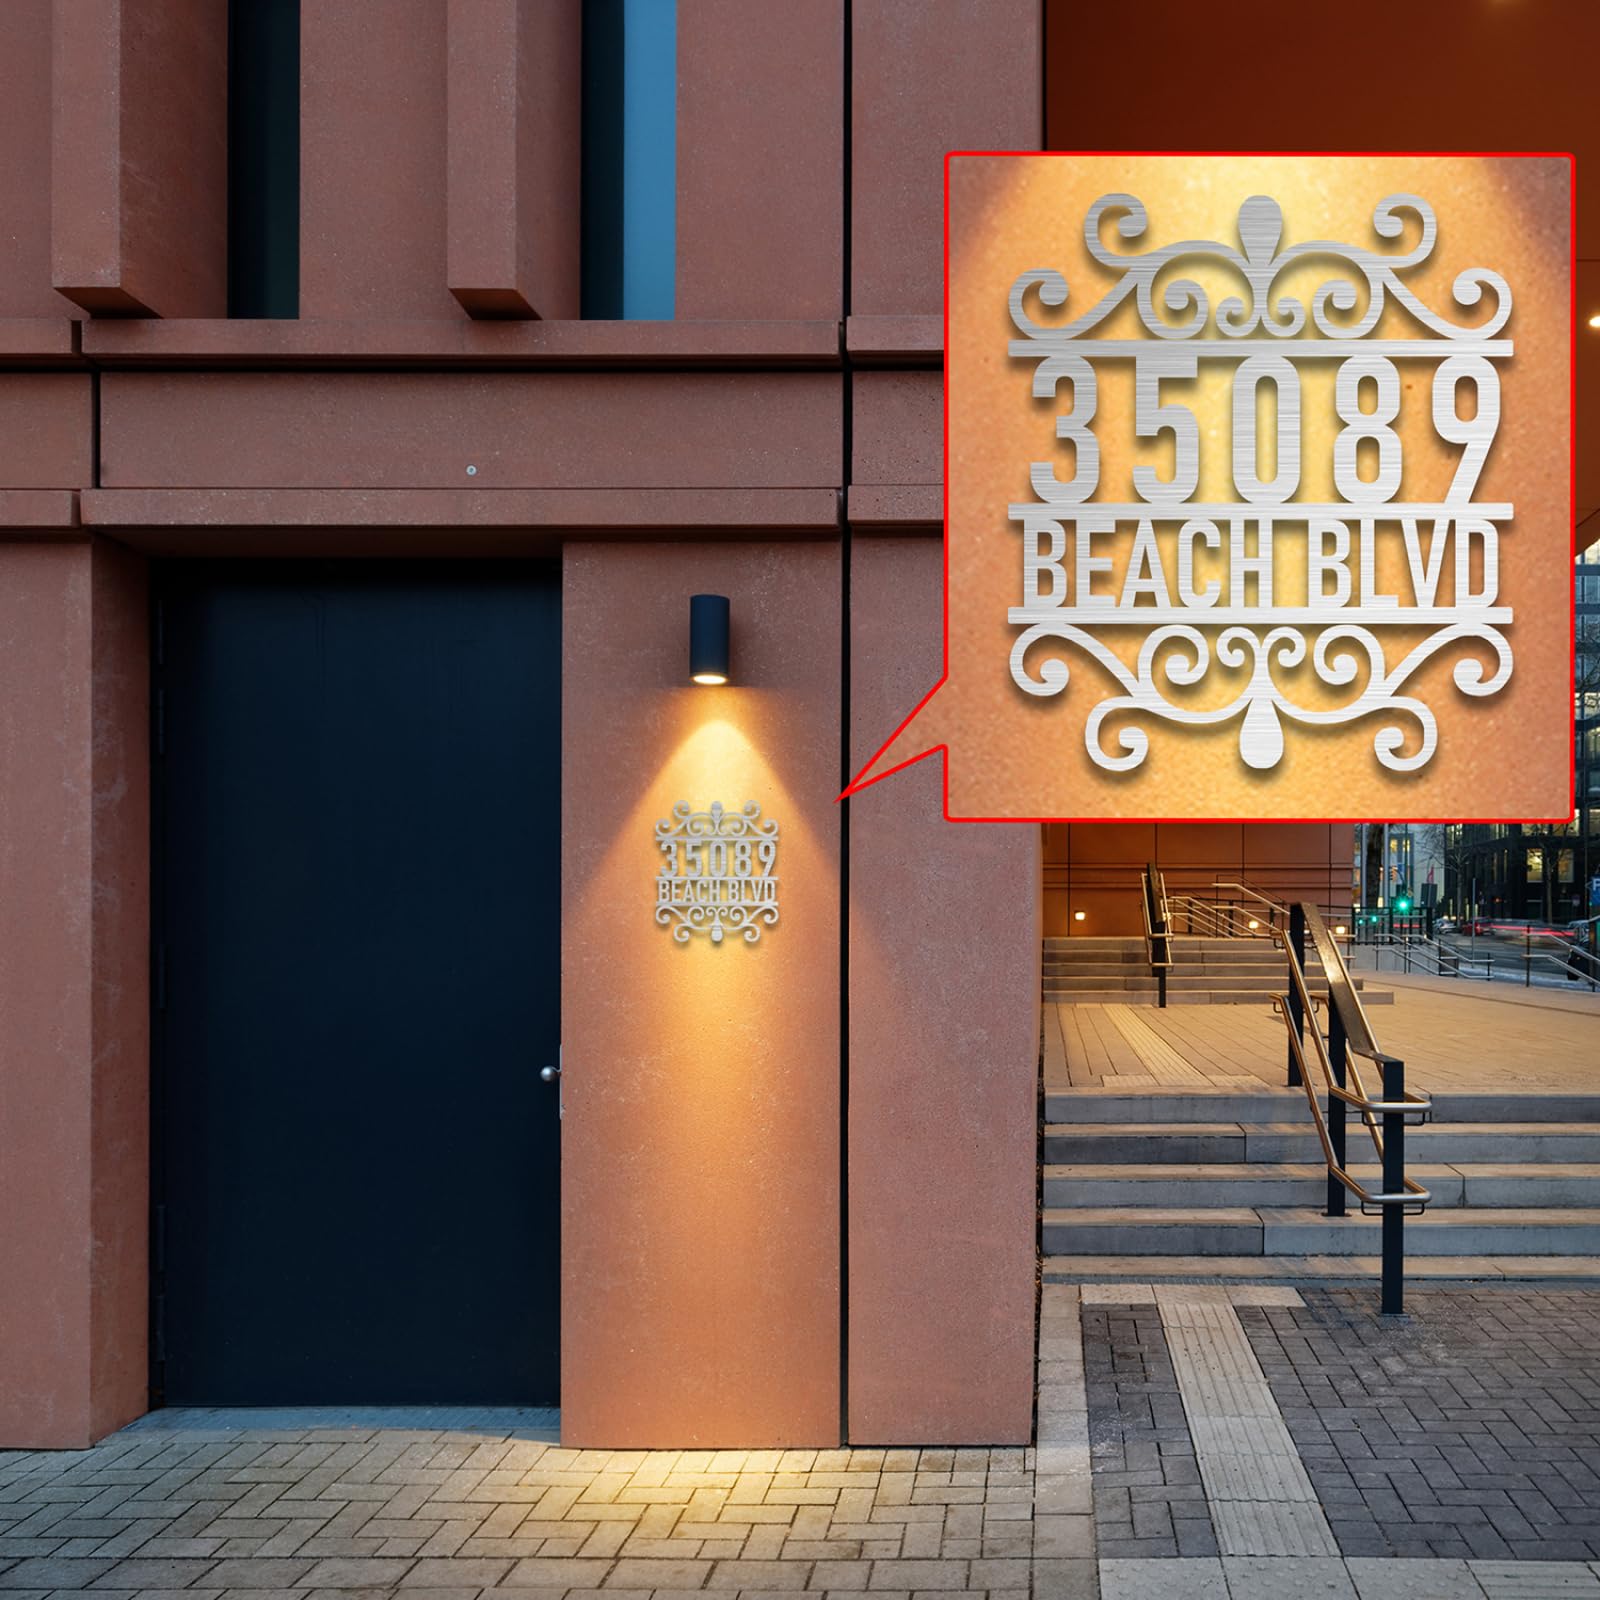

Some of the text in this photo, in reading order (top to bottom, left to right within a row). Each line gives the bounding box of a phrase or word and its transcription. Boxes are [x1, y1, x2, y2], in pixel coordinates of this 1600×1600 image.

[1030, 356, 1501, 503] 35089
[1023, 519, 1500, 608] BEACH BLVD
[660, 840, 776, 877] 35089
[658, 880, 775, 902] BEACH BLVD
